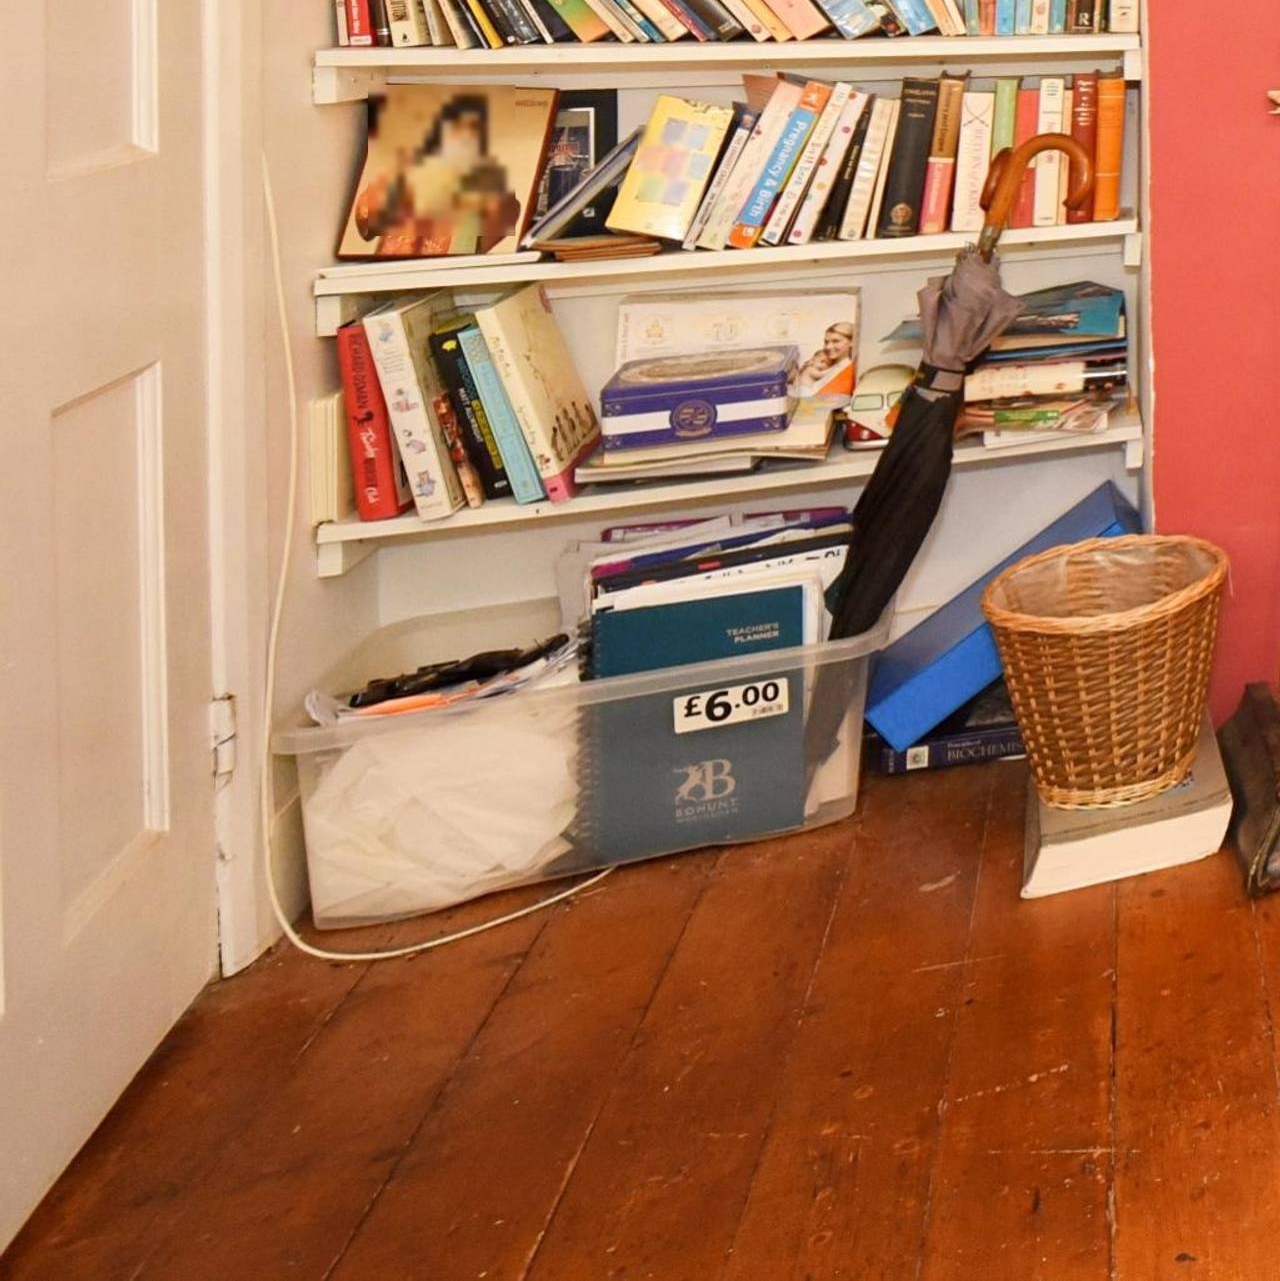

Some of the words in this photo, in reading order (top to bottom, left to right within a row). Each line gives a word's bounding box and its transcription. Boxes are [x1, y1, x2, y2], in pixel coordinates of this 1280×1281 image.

[768, 120, 808, 177] Pregnancy
[750, 189, 773, 218] Birth
[349, 332, 365, 374] RICHARD
[352, 375, 367, 409] OSMAN
[726, 622, 779, 637] TEACHER'S
[734, 630, 779, 644] PLANNER
[683, 681, 780, 722] £6.00
[946, 742, 1025, 761] BIOCHEMIS
[675, 798, 741, 818] BOHUNT
